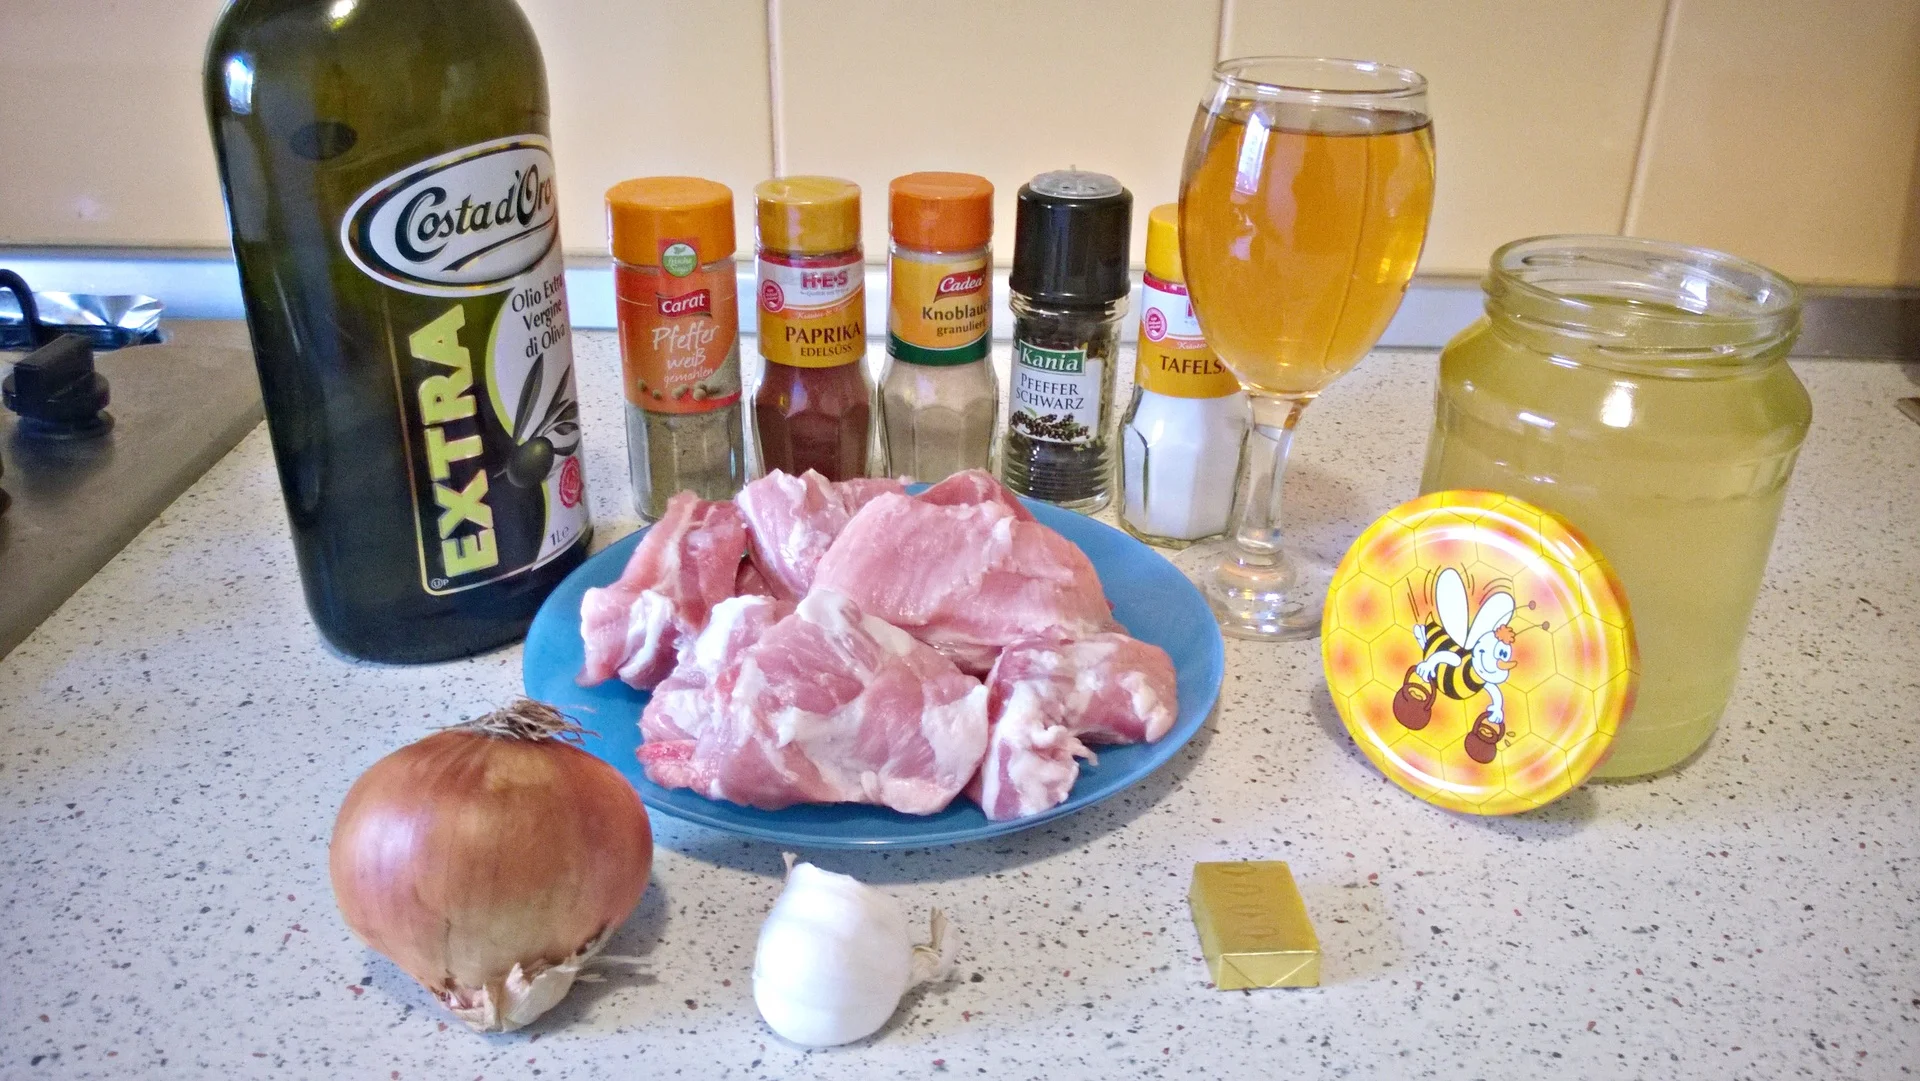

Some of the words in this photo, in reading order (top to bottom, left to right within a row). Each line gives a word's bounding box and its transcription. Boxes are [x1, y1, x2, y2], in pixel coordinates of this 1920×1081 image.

[511, 288, 541, 312] Olio
[544, 274, 563, 299] Extra
[940, 276, 983, 293] Cadea
[522, 299, 562, 331] Vergine
[661, 293, 705, 314] Carat
[526, 337, 538, 358] di
[541, 324, 566, 350] Oliva
[652, 319, 720, 353] Pfeffer
[785, 321, 861, 344] PAPRIKA
[1021, 347, 1079, 371] Kania
[1160, 355, 1226, 375] TAFELS
[663, 367, 714, 388] gemahlen
[1020, 373, 1079, 396] PFEFFER
[1016, 387, 1085, 410] SCHWARZ
[408, 303, 499, 578] EXTRA
